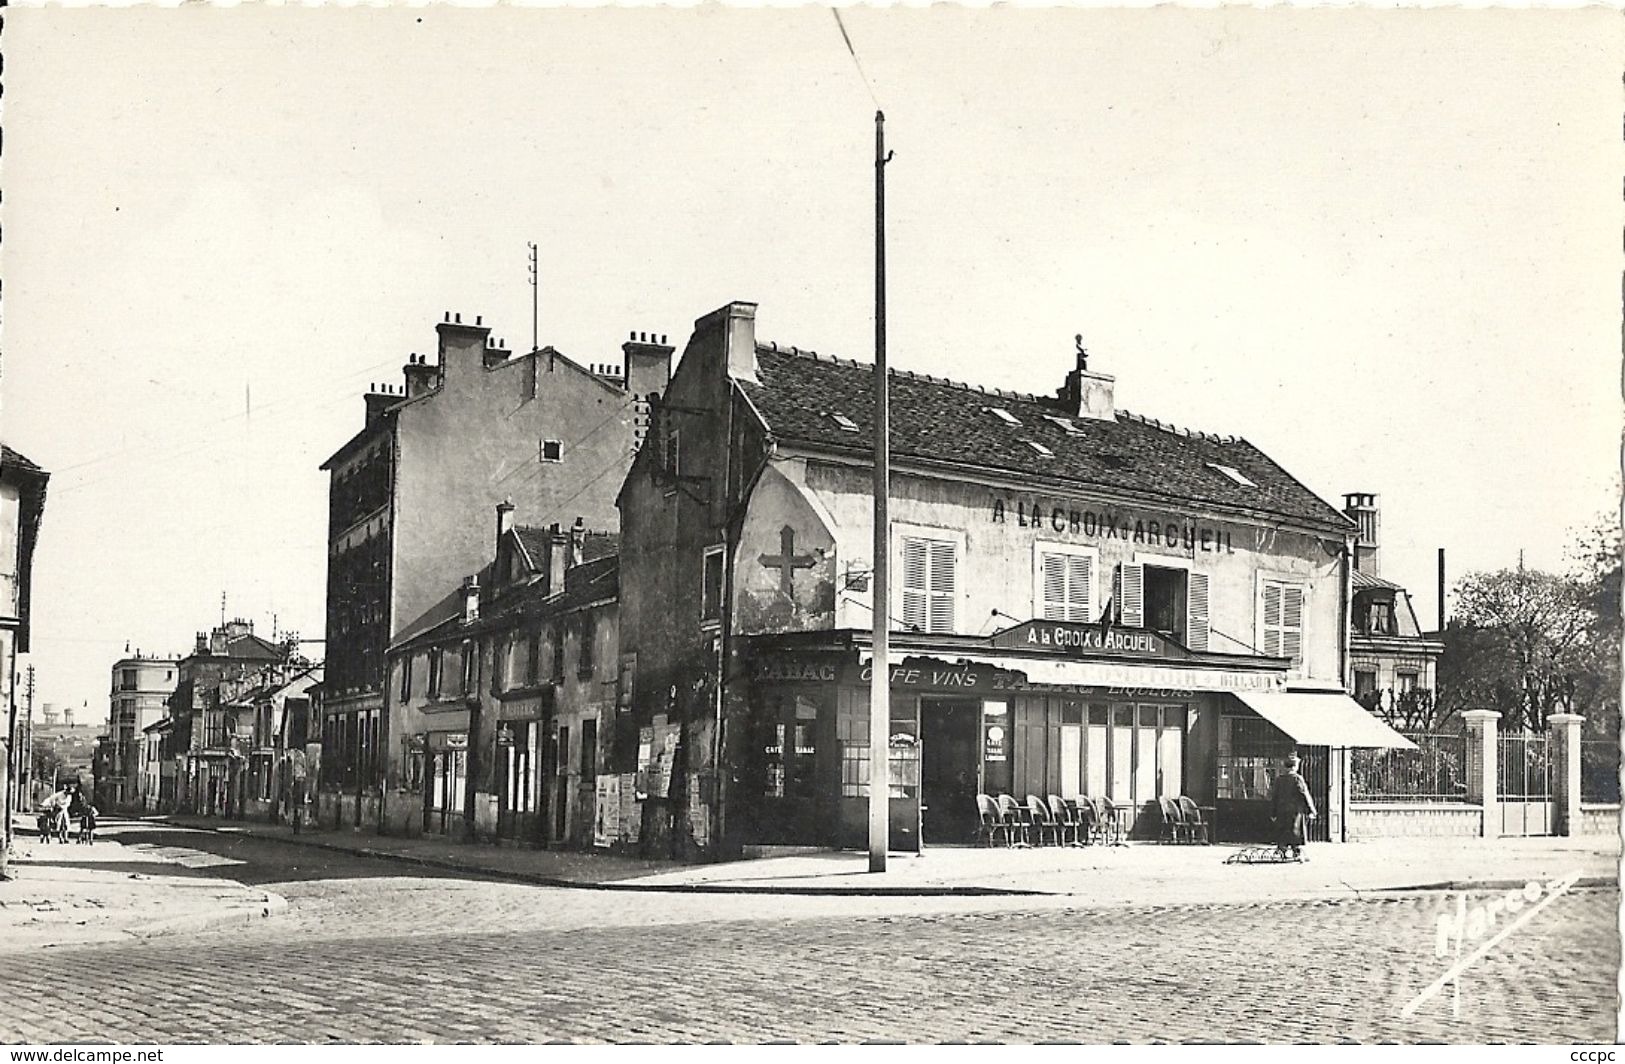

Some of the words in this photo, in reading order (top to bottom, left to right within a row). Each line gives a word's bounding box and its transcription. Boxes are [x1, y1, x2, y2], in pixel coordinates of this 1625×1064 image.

[992, 498, 1005, 524] A
[1017, 501, 1042, 529] LA
[1052, 507, 1118, 540] CROIX
[1132, 519, 1236, 555] ARCUEIL
[1027, 627, 1038, 644] A
[1041, 628, 1051, 644] la
[1104, 631, 1157, 652] ARCUEIL
[860, 667, 920, 684] CFE
[931, 671, 978, 686] VINS
